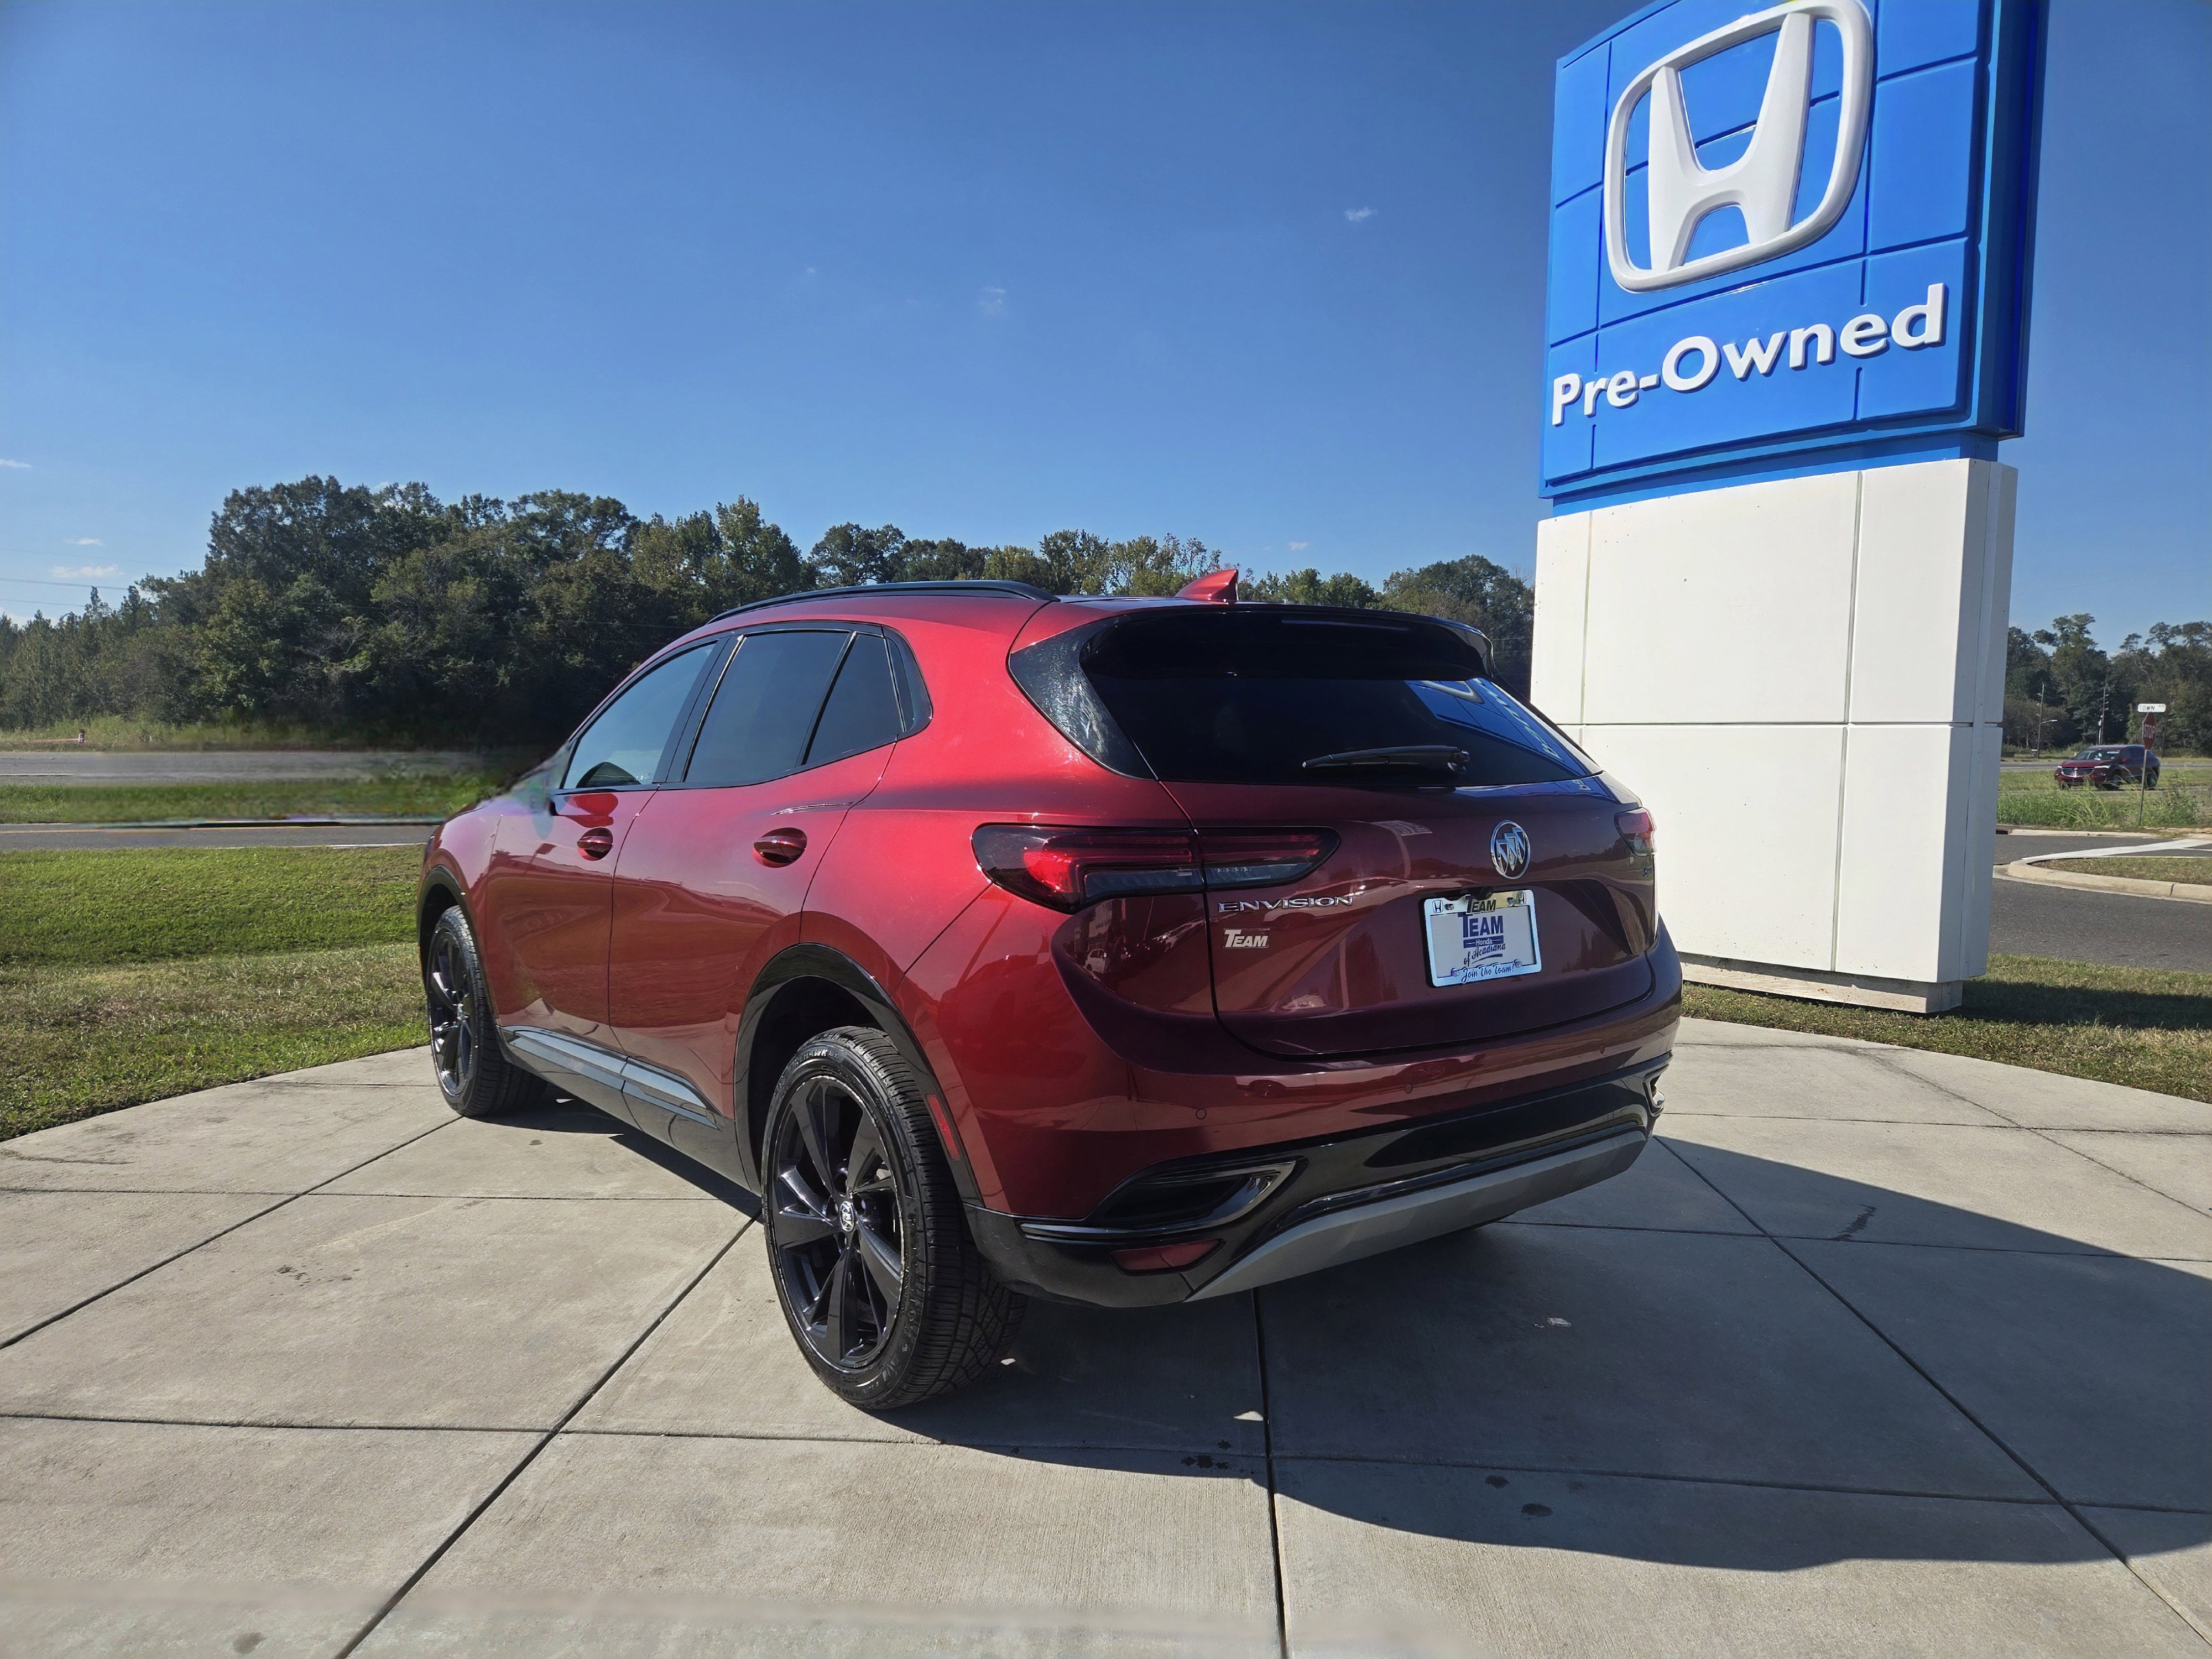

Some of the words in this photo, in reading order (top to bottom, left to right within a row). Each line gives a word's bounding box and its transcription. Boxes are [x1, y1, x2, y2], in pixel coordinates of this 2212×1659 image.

[1552, 283, 1946, 426] Pre-Owned
[2144, 724, 2156, 739] STOP
[1218, 896, 1353, 912] ENVISION
[1464, 894, 1497, 914] TEAM
[1458, 912, 1504, 938] TEAM
[1224, 929, 1269, 947] TEAM
[1464, 951, 1471, 967] of
[1472, 943, 1506, 959] Acadiana
[1462, 968, 1478, 983] Join
